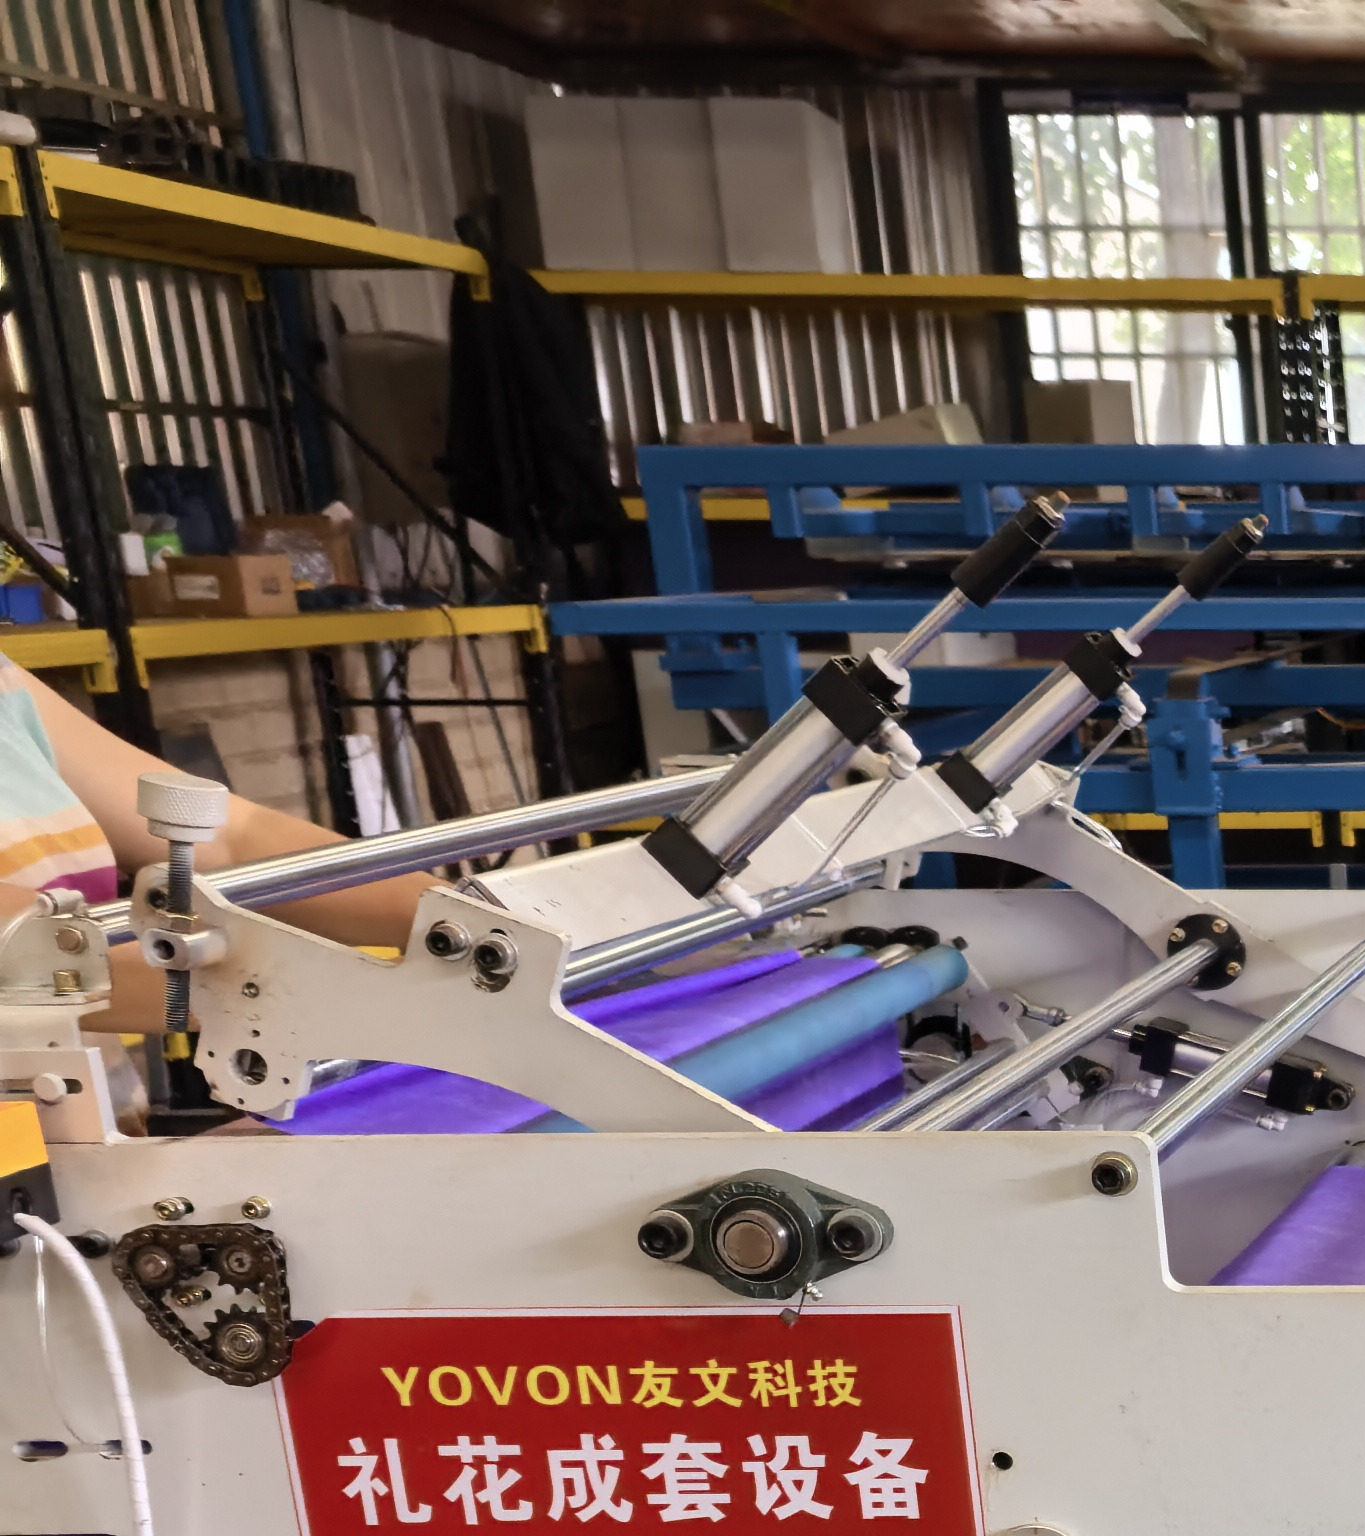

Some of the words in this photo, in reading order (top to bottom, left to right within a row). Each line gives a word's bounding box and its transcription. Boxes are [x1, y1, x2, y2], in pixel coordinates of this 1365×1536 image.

[381, 1358, 862, 1408] YOVON友文科技
[338, 1432, 928, 1525] 礼花成套设备
